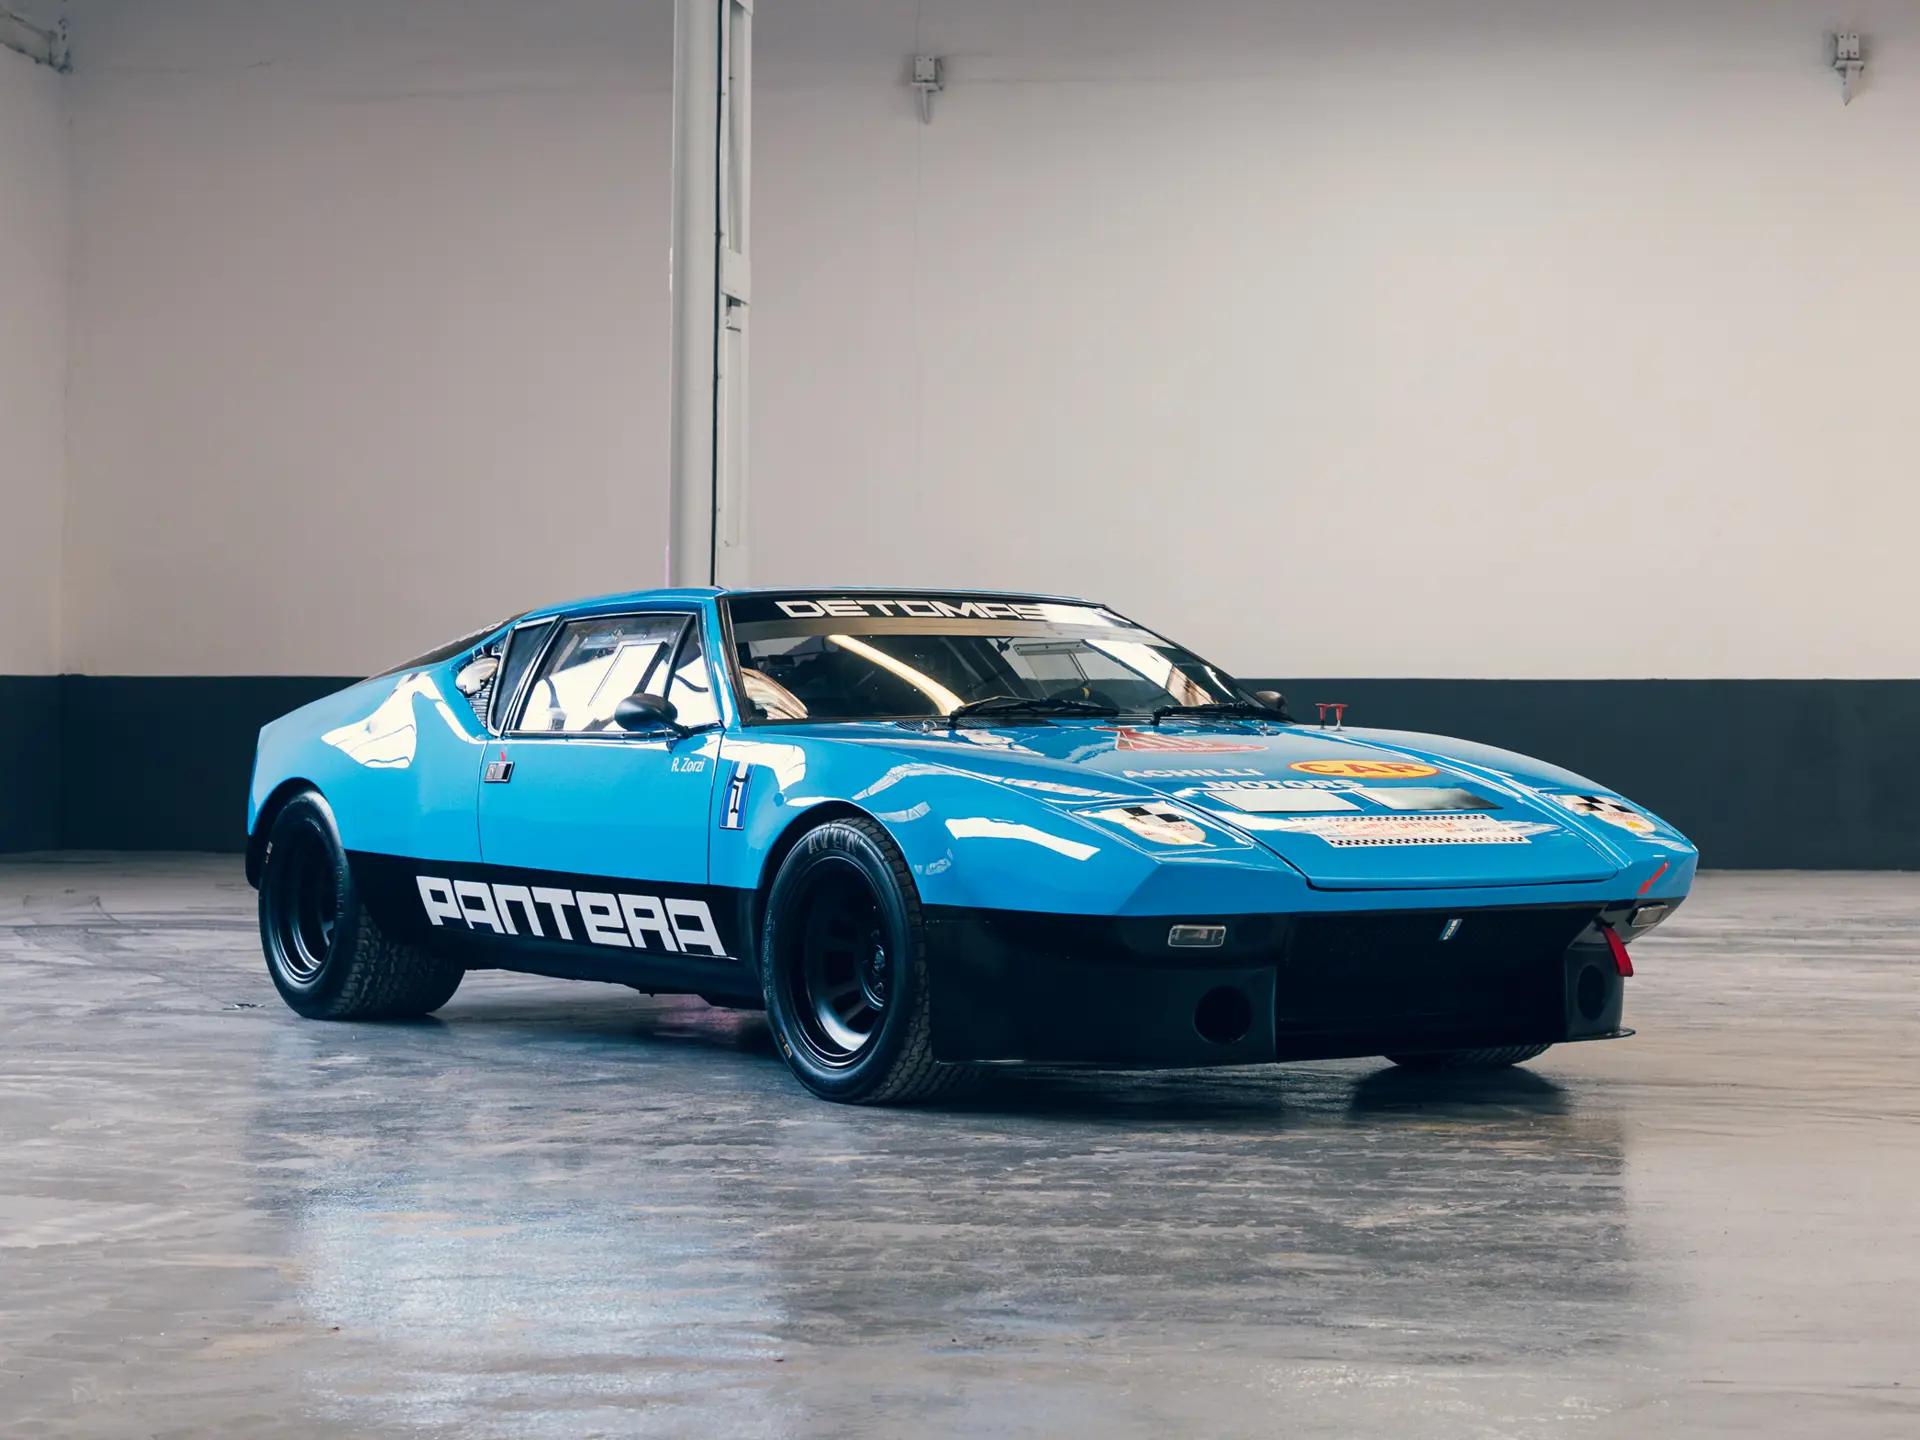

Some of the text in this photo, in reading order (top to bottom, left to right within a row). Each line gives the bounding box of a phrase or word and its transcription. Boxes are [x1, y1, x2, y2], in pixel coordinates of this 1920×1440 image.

[680, 757, 706, 772] Zorzi
[1298, 763, 1427, 773] CAR
[1122, 767, 1265, 778] ACHILLI
[1201, 779, 1366, 790] MOTORS
[807, 827, 859, 855] AVON
